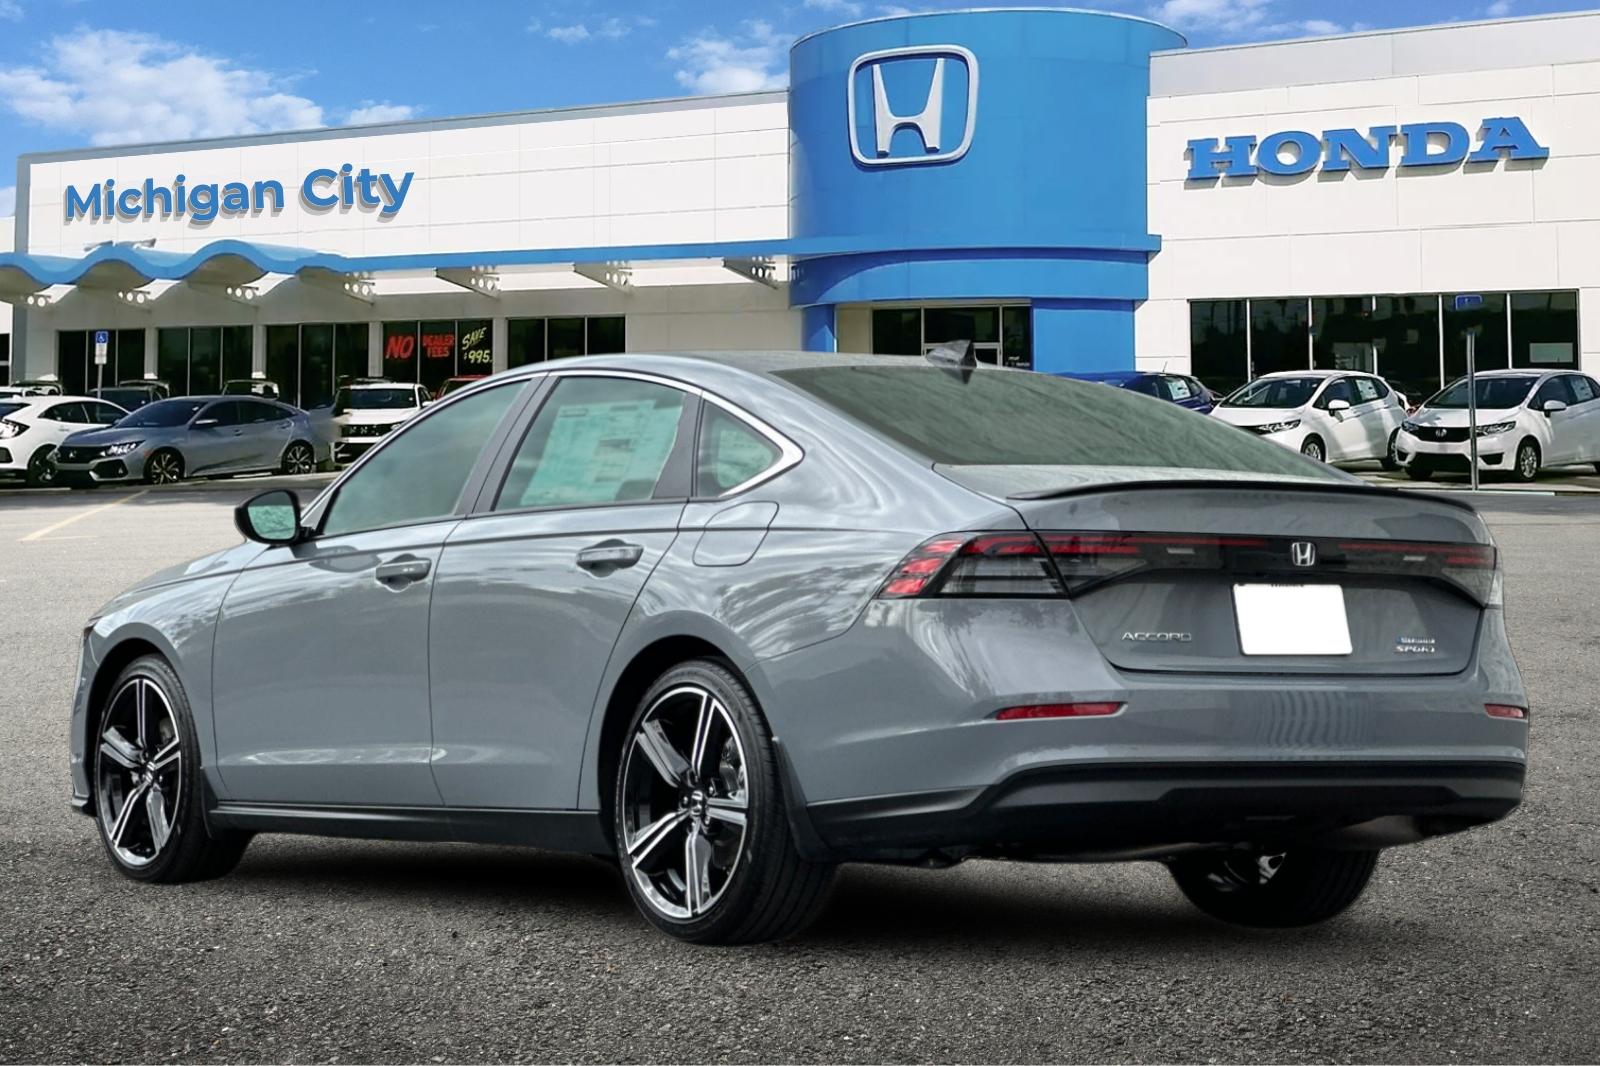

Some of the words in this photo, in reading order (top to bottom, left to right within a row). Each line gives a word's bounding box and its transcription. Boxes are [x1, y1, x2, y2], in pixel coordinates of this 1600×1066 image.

[1186, 116, 1549, 181] HONDA
[65, 174, 284, 222] Michigan
[301, 163, 415, 214] City
[385, 335, 415, 359] NO
[462, 327, 487, 350] SAVE
[1121, 632, 1192, 642] ACCORD
